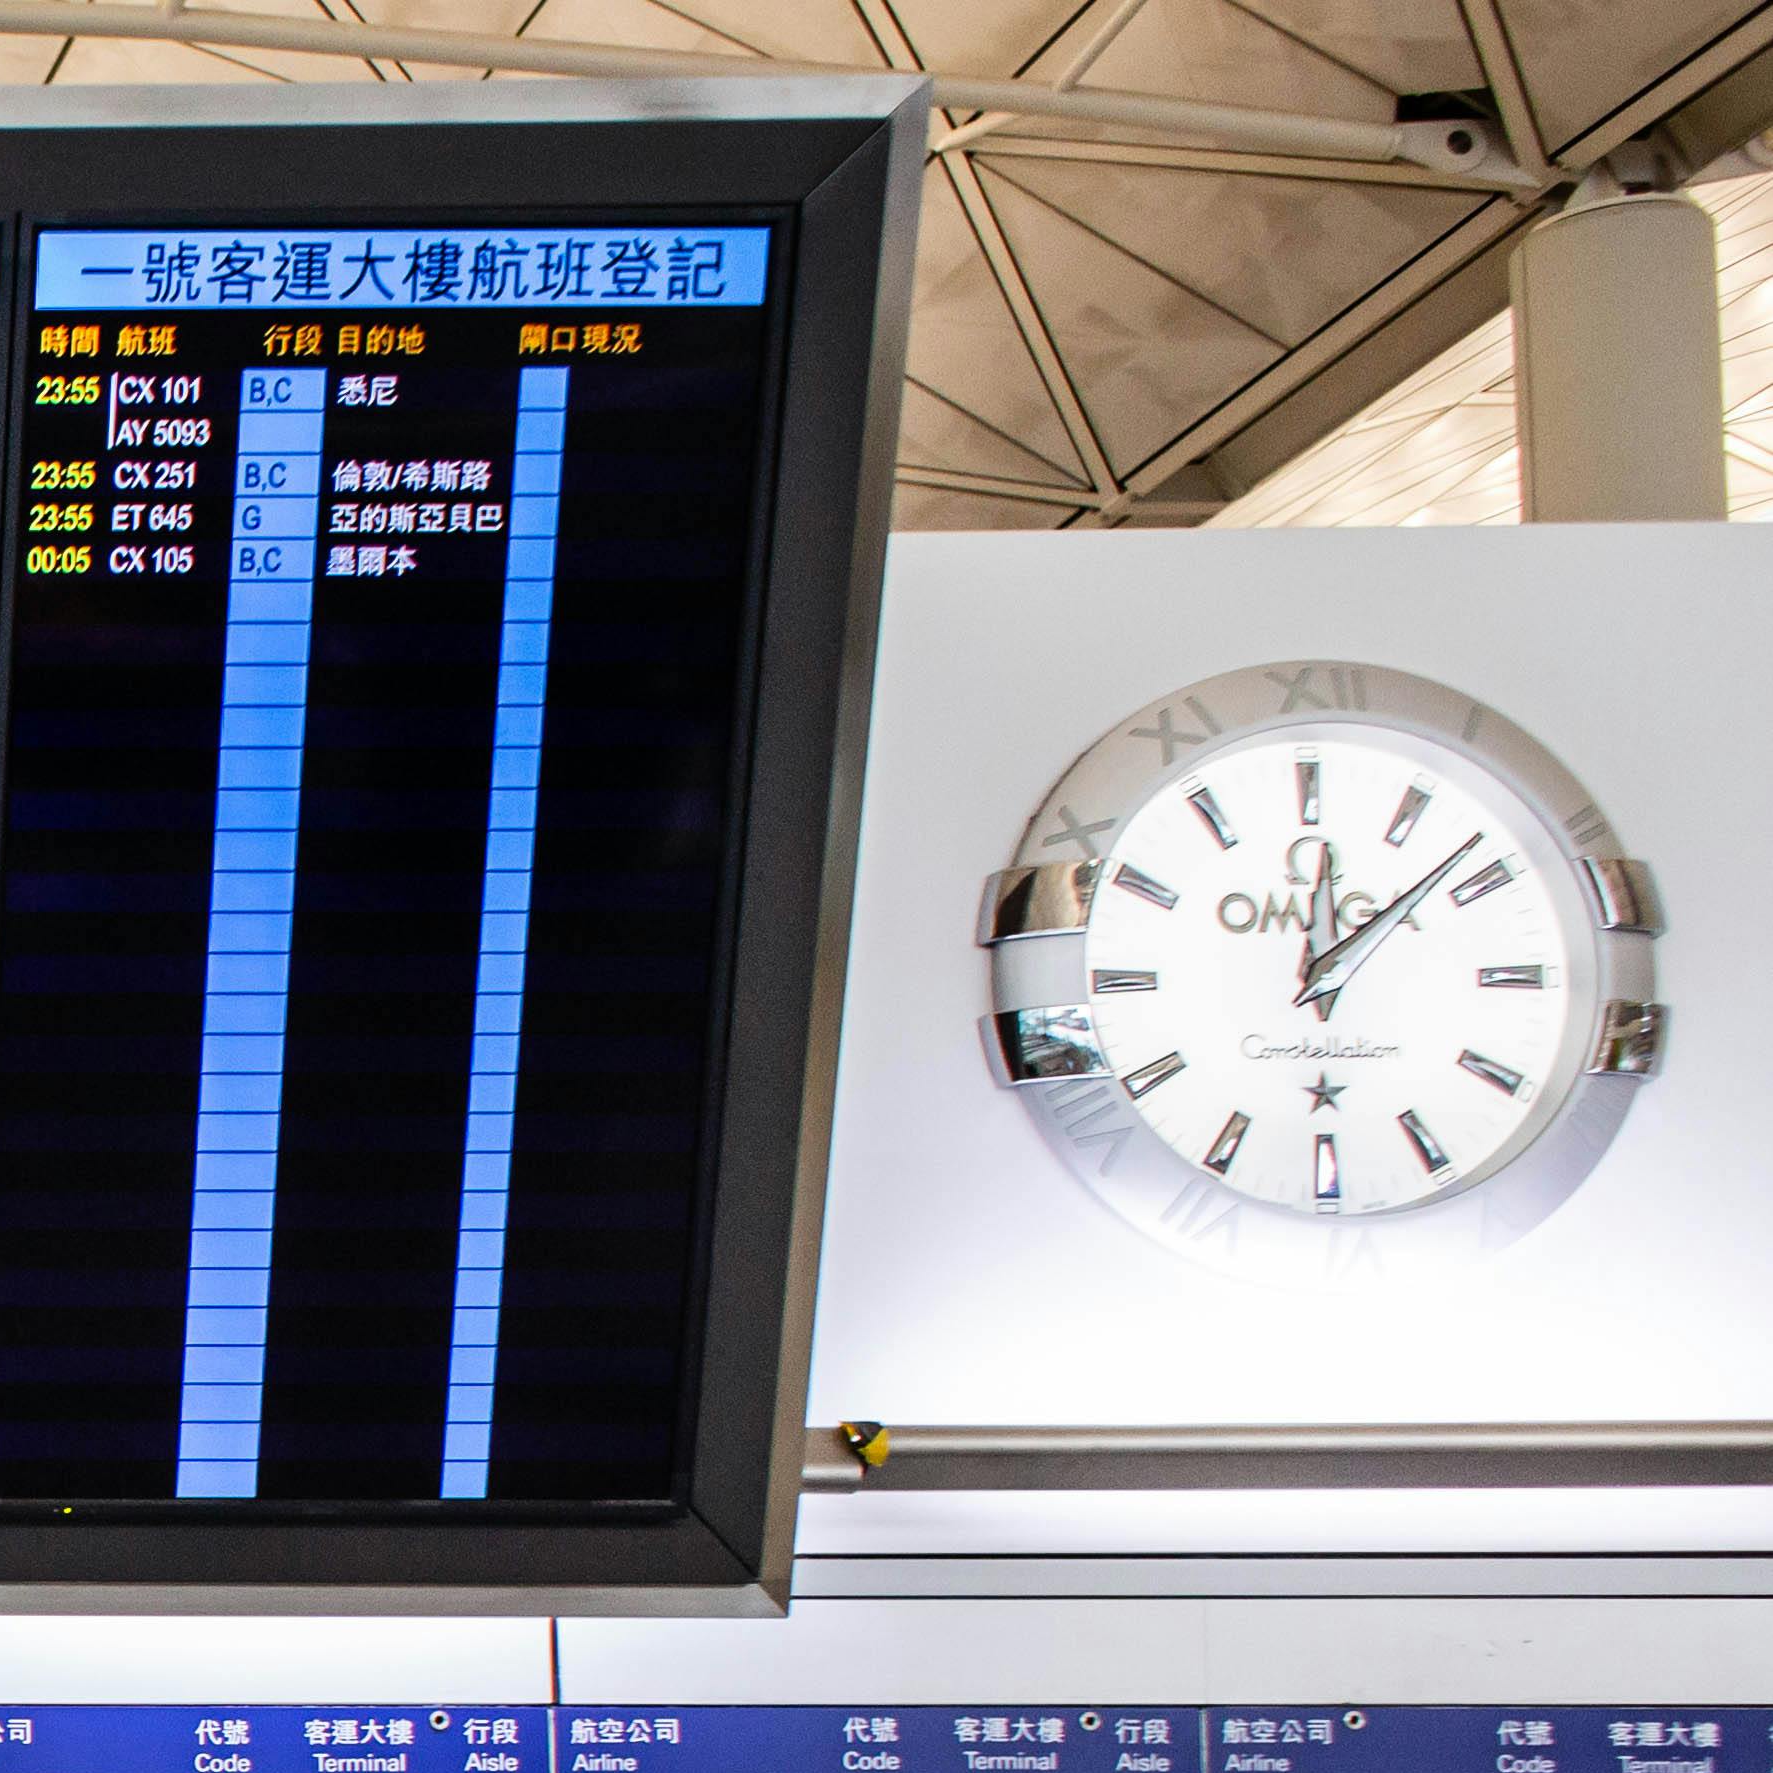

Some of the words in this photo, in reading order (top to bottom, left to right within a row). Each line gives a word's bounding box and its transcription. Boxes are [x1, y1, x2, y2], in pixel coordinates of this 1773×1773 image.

[81, 240, 727, 301] 一號客運大樓航班登記
[40, 324, 100, 357] 時間
[116, 325, 176, 356] 航班
[263, 325, 322, 356] 行段
[338, 325, 425, 355] 目的地
[519, 324, 576, 354] 閘口
[582, 324, 642, 353] 現況
[35, 376, 100, 404] 23:55
[119, 376, 156, 404] CX
[161, 376, 201, 404] 101
[249, 377, 291, 407] B,C
[337, 374, 398, 406] 悉尼
[115, 419, 150, 446] AY
[153, 419, 211, 446] 5093
[31, 461, 96, 489] 23:55
[113, 461, 151, 489] CX
[154, 461, 196, 489] 251
[244, 461, 286, 492] B,C
[332, 460, 492, 492] 倫敦/希斯路
[1240, 1033, 1400, 1060] Constellation
[1222, 1719, 1333, 1744] 航空公司
[1497, 1721, 1554, 1745] 代號
[1608, 1722, 1721, 1747] 客運大樓
[1224, 1753, 1292, 1772] Airline
[1496, 1754, 1556, 1773] Code
